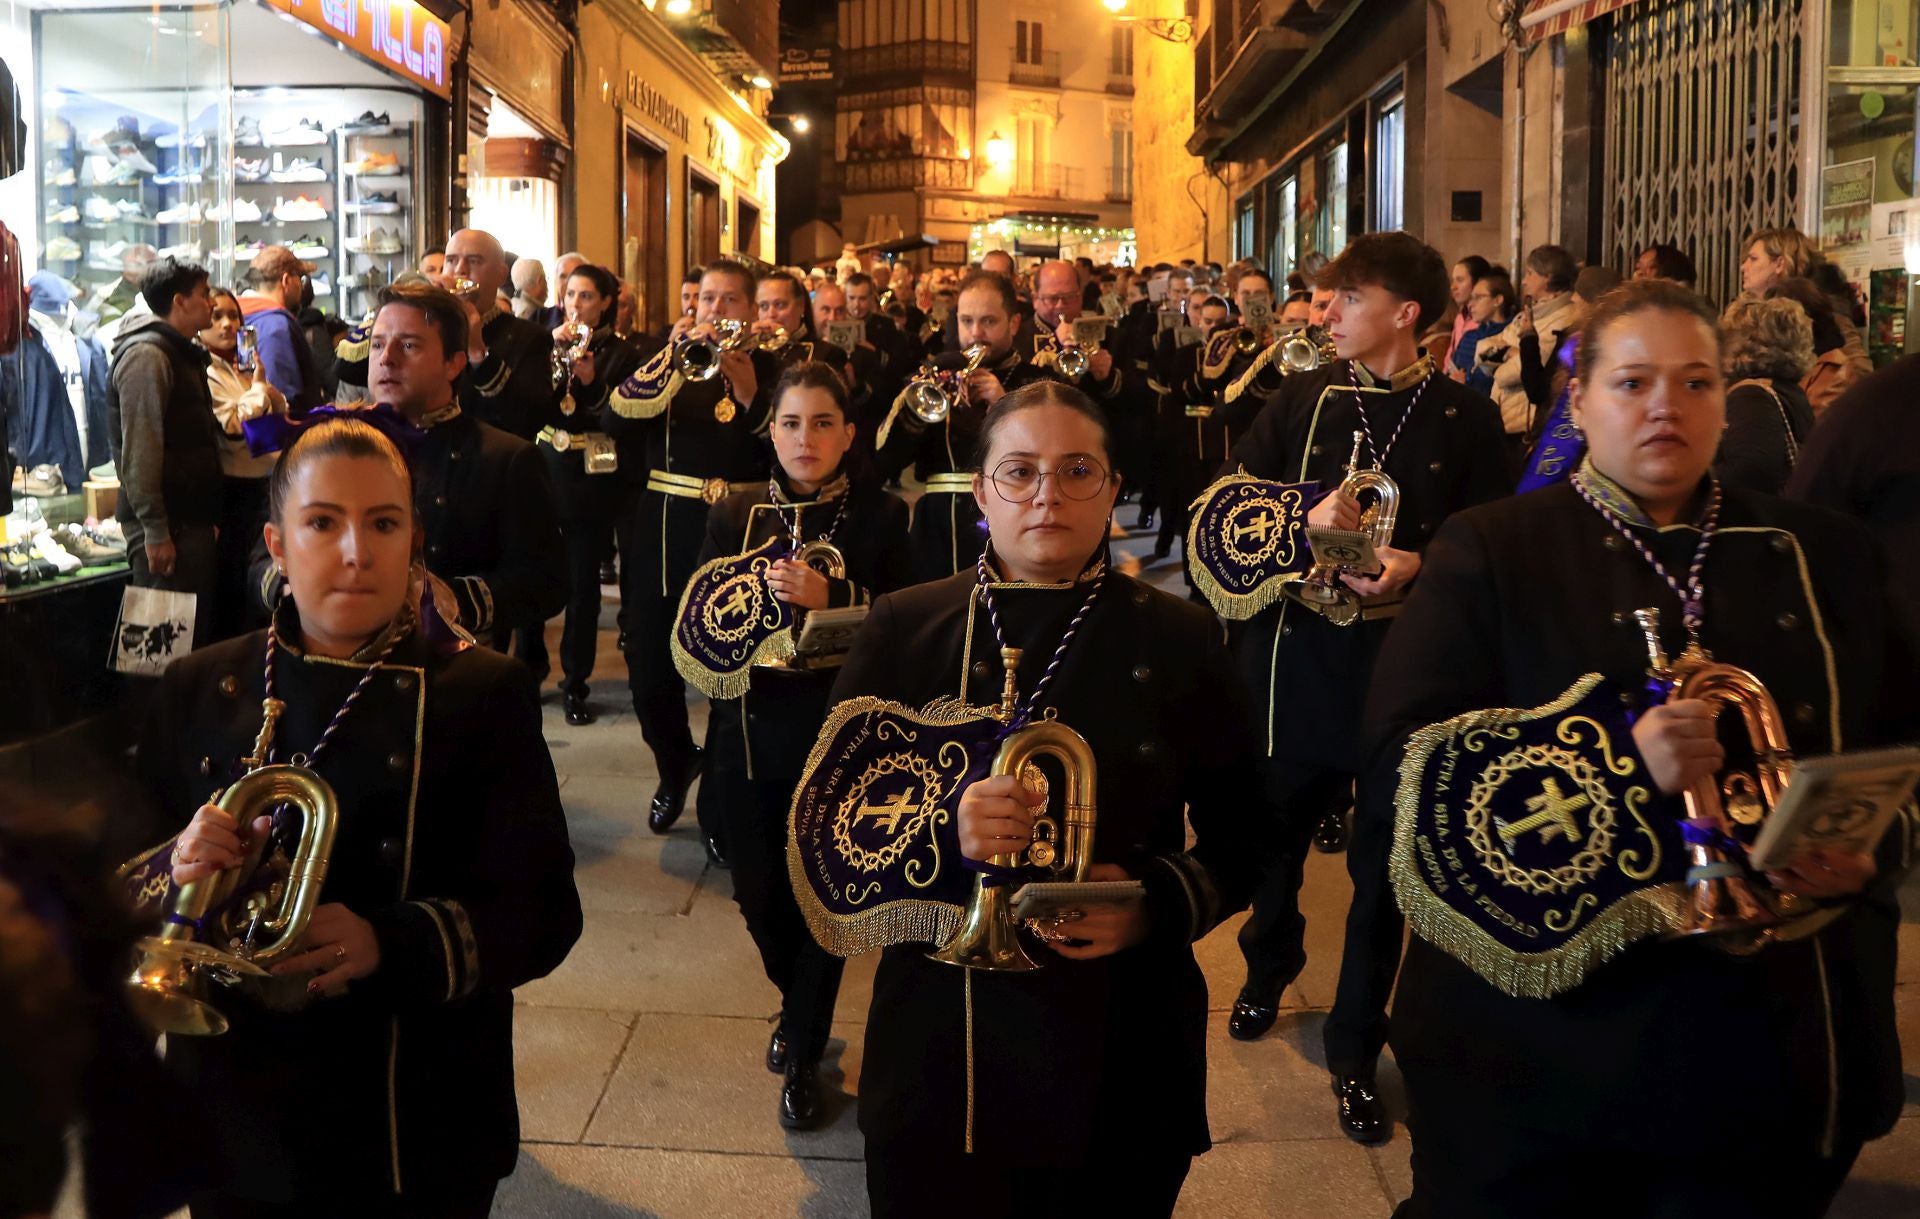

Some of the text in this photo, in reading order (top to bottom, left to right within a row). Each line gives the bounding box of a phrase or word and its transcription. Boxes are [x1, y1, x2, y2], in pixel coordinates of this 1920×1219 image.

[626, 69, 689, 144] RESTAURANTE
[1200, 527, 1208, 558] SEGOVIA
[1208, 535, 1216, 549] DE
[1211, 550, 1219, 561] LA
[1216, 561, 1239, 588] PIEDAD
[703, 646, 730, 667] PIEDAD
[800, 786, 818, 836] SEGOVIA
[815, 803, 828, 824] DE
[813, 827, 821, 847] LA
[814, 849, 840, 900] PIEDAD
[1415, 834, 1450, 893] SEGOVIA
[1441, 846, 1463, 871] DE
[1455, 872, 1478, 896] LA
[1475, 895, 1540, 938] PIEDAD
